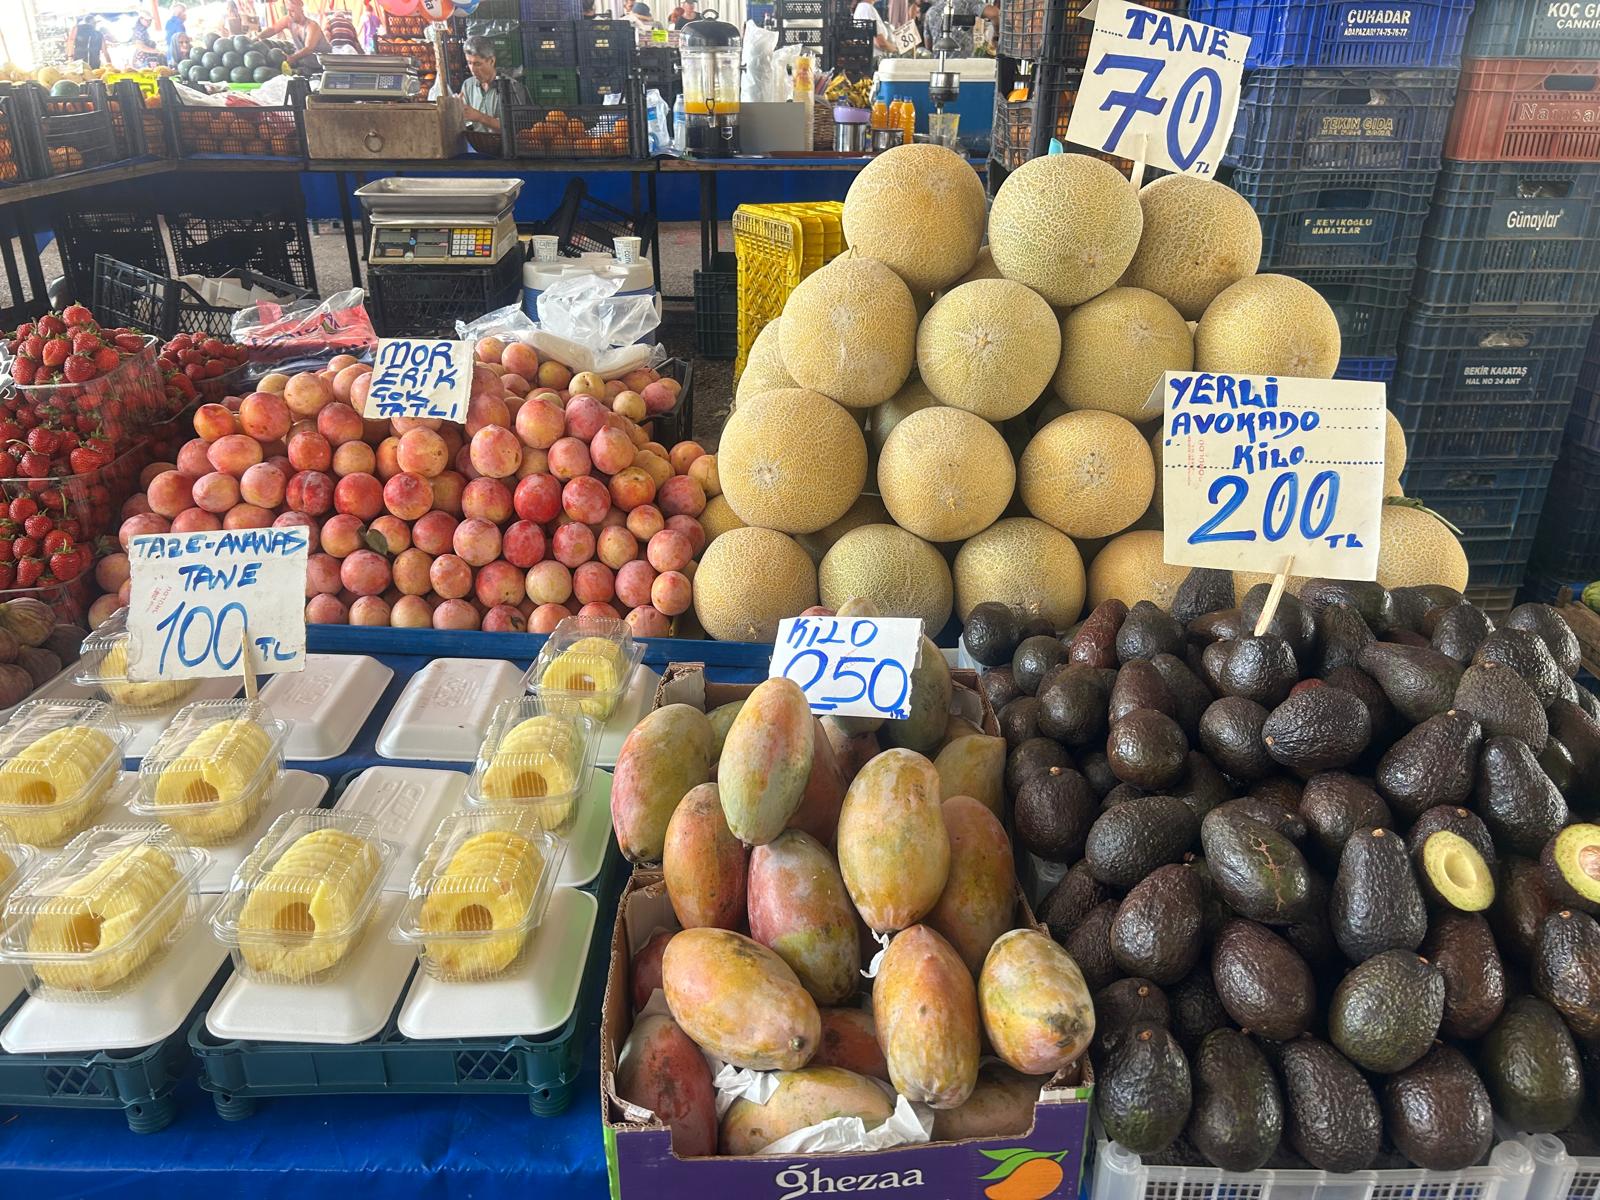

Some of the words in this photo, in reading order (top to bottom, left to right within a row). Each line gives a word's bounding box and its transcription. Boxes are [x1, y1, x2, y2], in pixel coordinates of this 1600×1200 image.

[1347, 9, 1411, 27] ÇUHADAR
[1547, 2, 1581, 19] KOÇ
[901, 32, 915, 48] 80
[1093, 53, 1222, 172] 70
[1195, 161, 1210, 173] TL
[1507, 210, 1560, 231] Günaylar
[379, 341, 454, 372] MOR
[1489, 366, 1528, 377] KARATAŞ
[1170, 410, 1321, 444] AVOKADO
[1187, 470, 1341, 545] 200
[1324, 533, 1364, 549] TL
[178, 562, 263, 592] TANE
[156, 600, 249, 676] 100
[255, 636, 297, 662] TL
